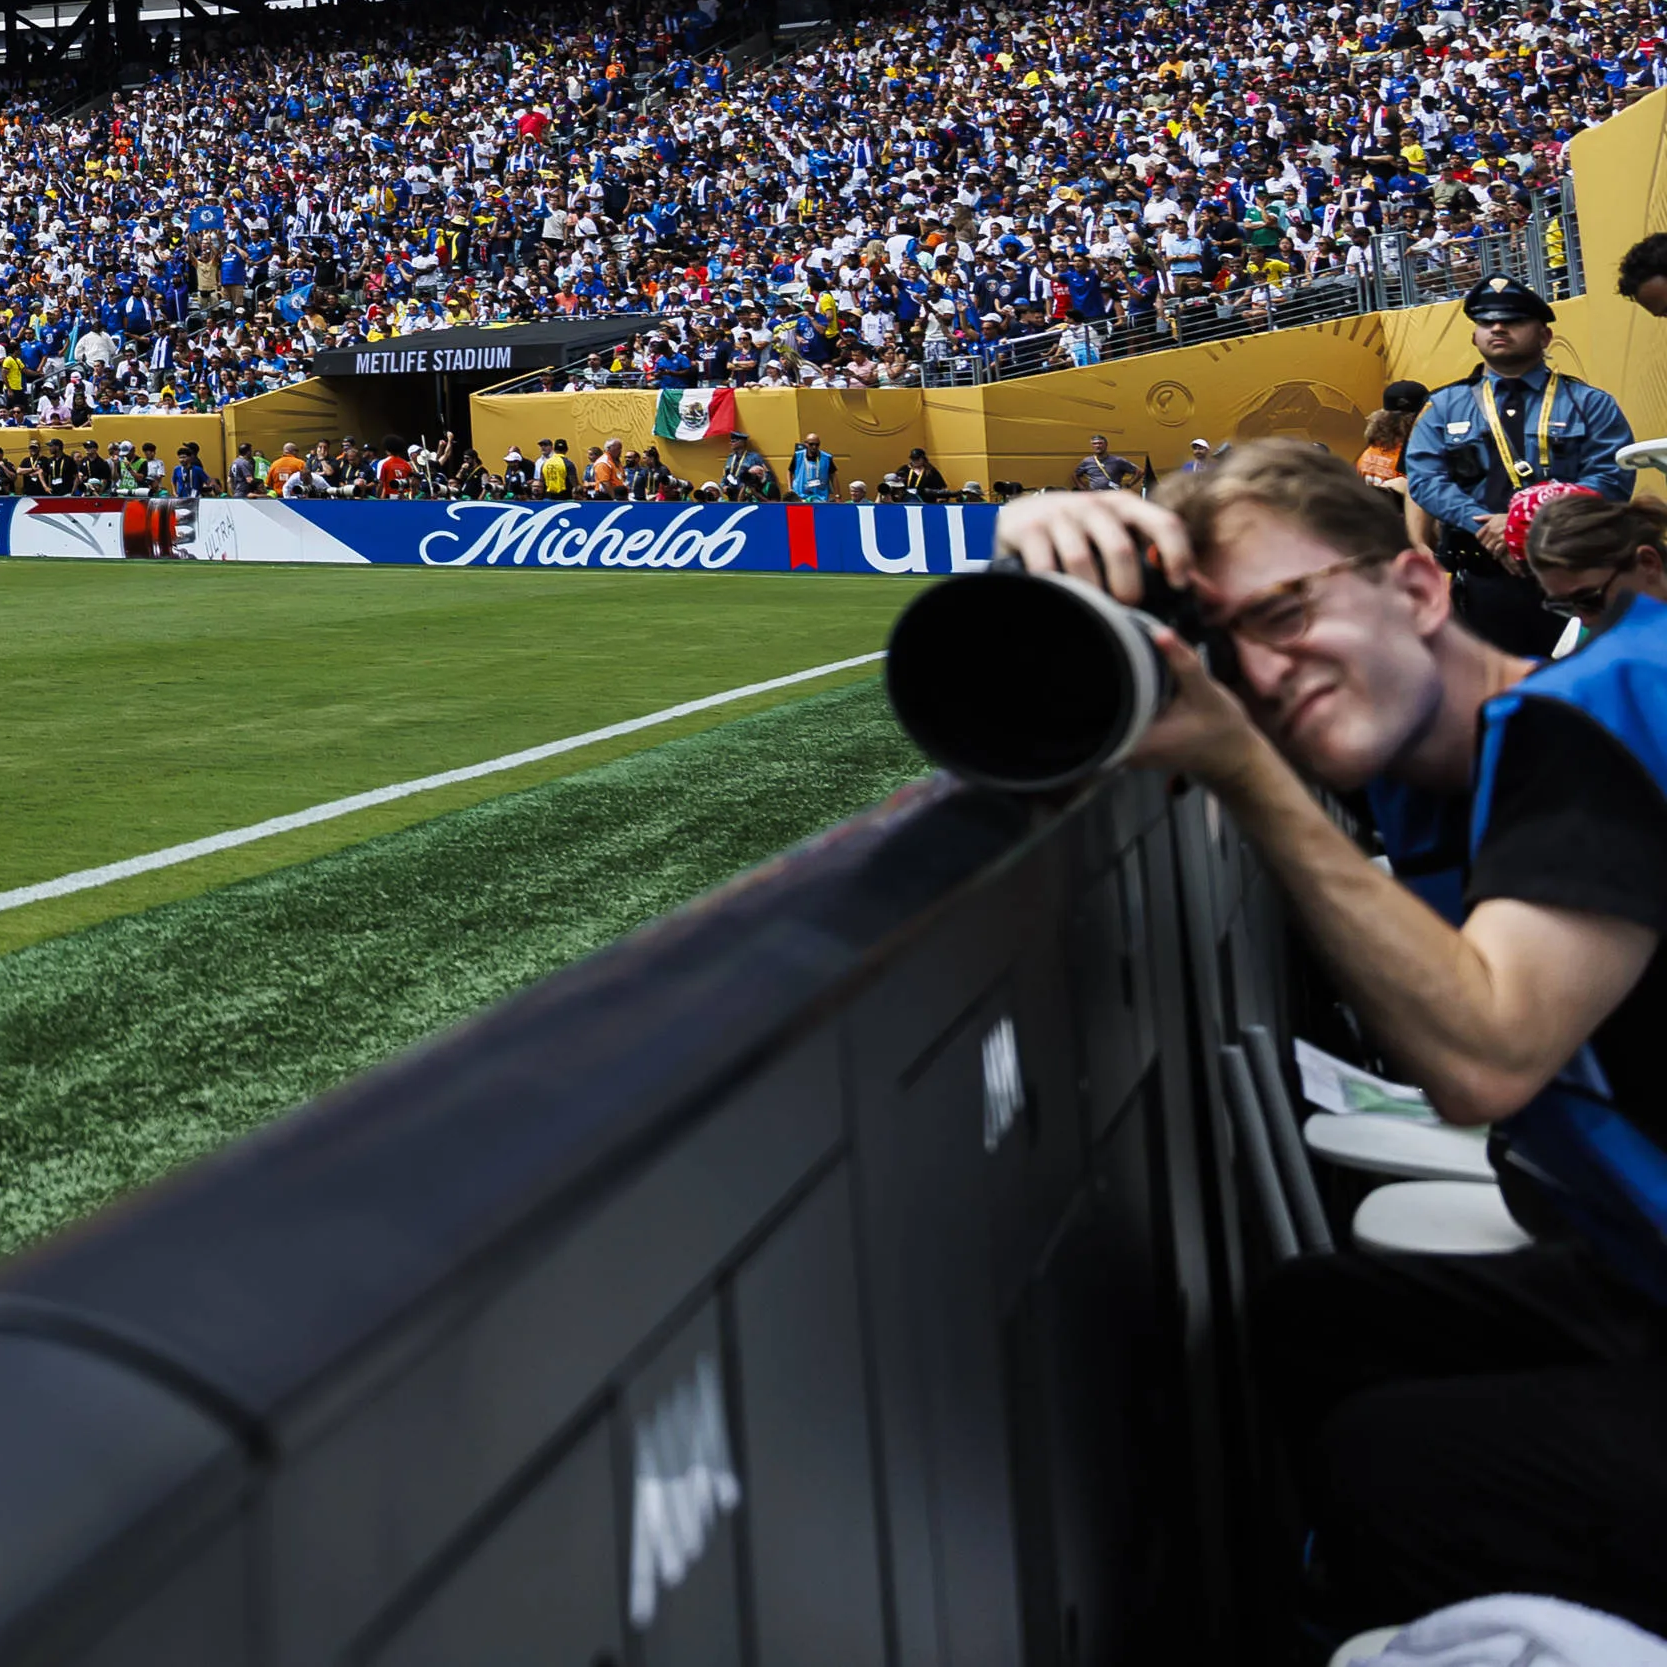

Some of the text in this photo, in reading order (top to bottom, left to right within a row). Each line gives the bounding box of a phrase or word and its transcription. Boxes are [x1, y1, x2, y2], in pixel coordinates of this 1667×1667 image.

[356, 346, 512, 375] METLIFE STADIUM
[419, 500, 759, 570] Michelob
